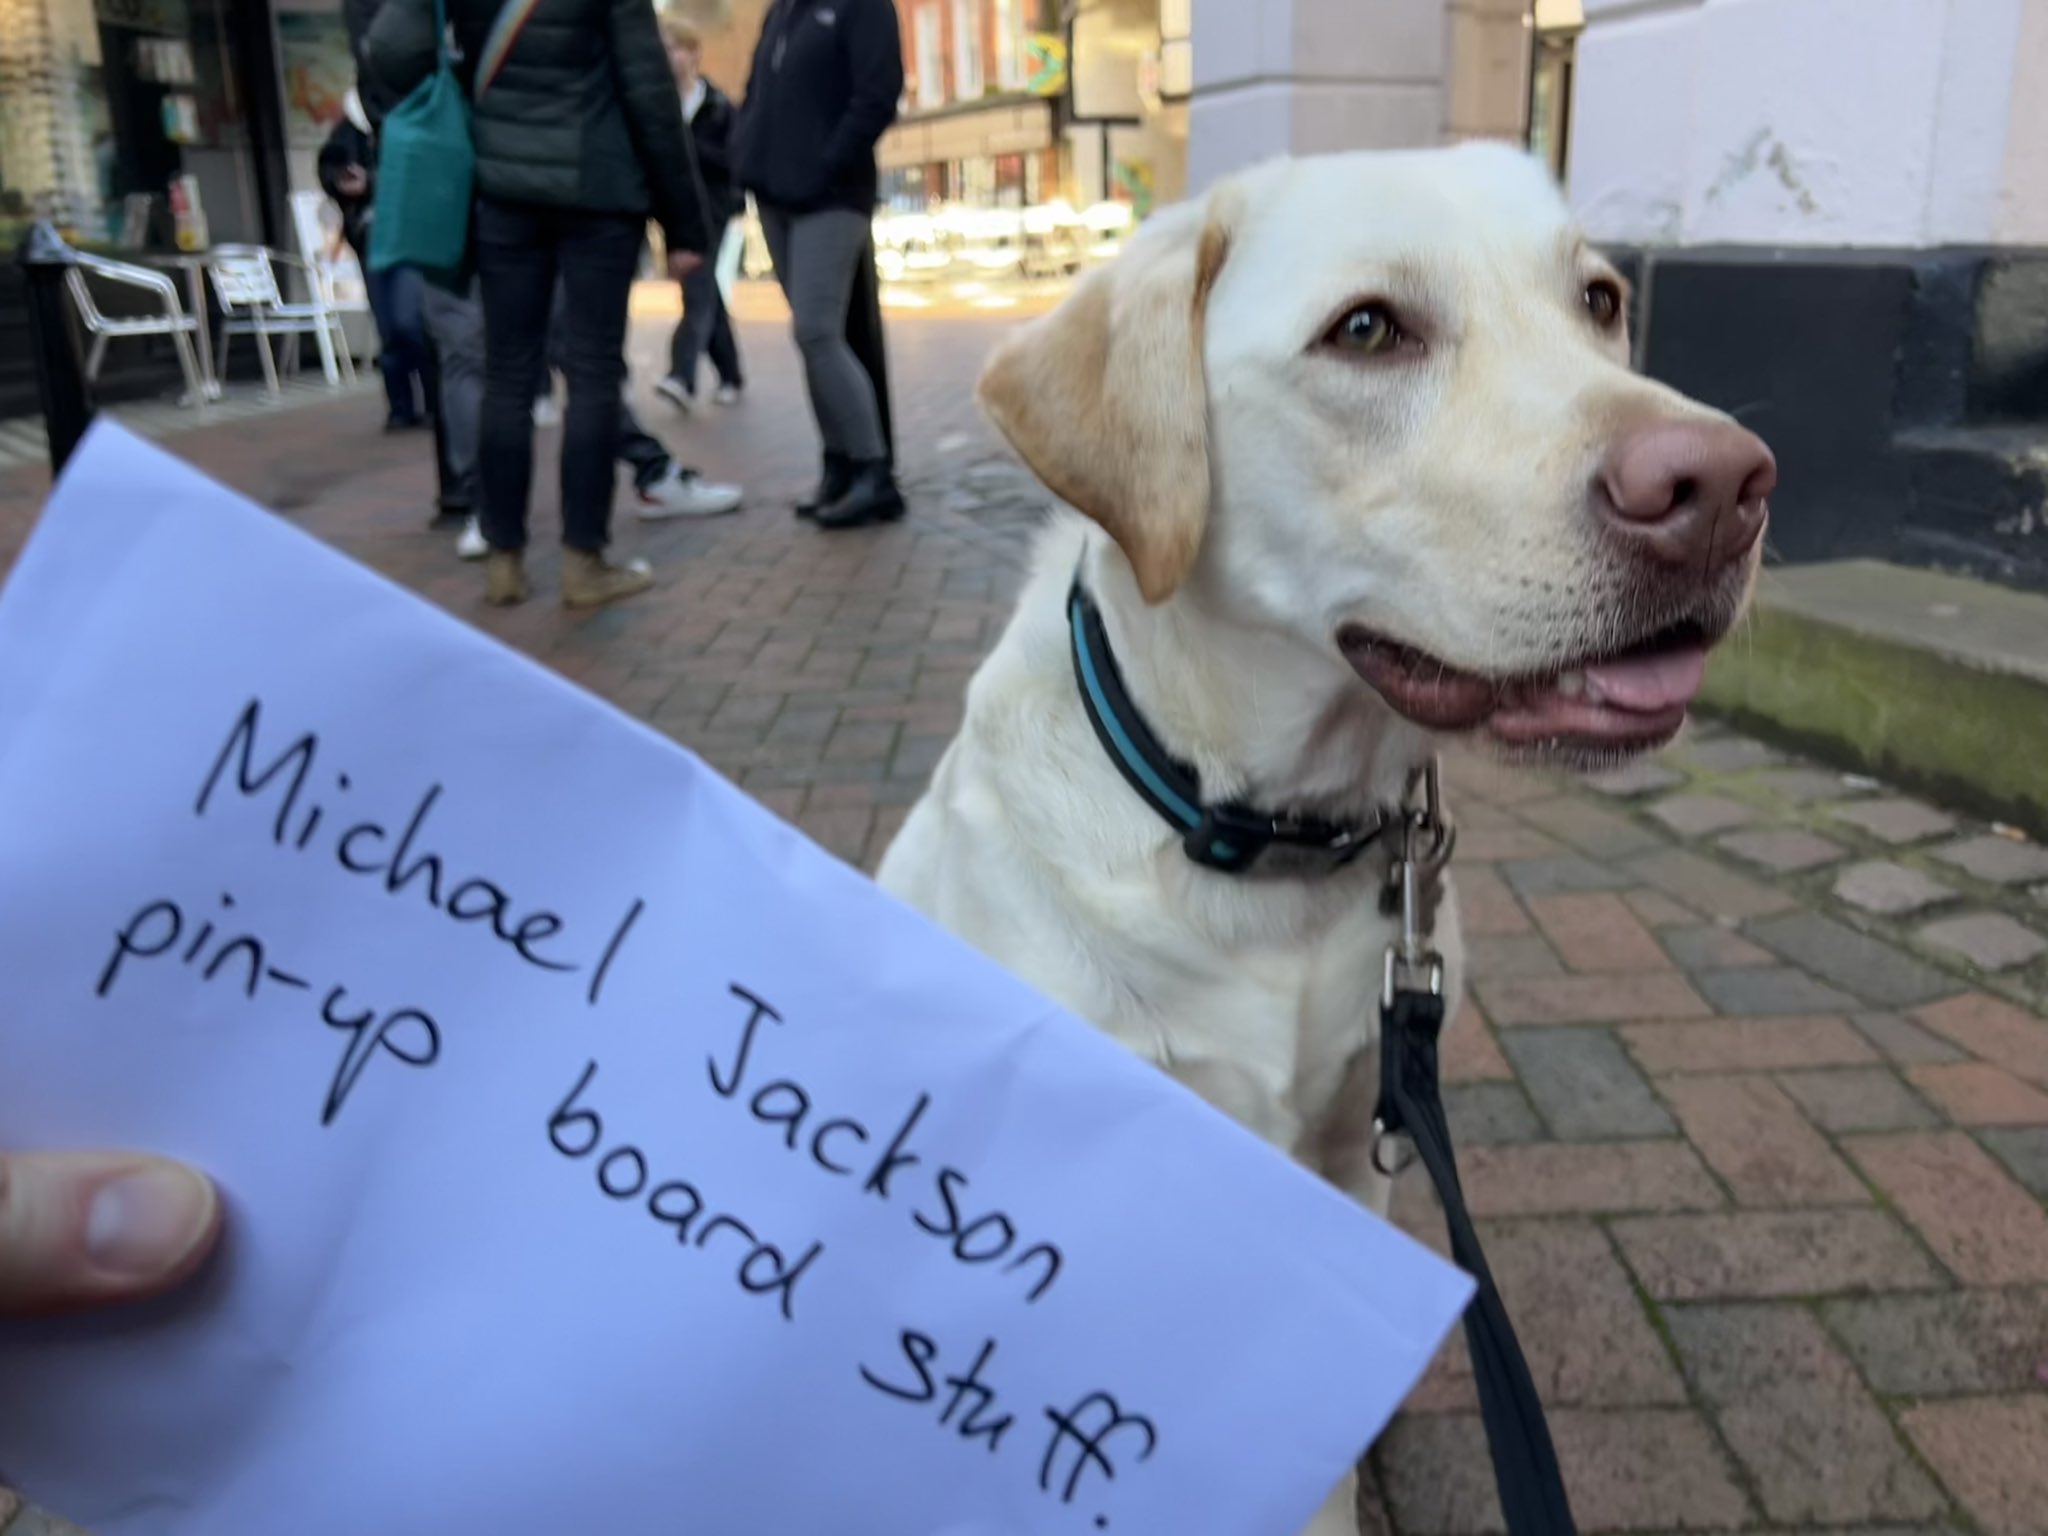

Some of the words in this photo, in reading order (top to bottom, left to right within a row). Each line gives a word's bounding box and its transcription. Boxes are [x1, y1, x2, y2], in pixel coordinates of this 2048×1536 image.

[95, 892, 442, 1128] pin-up
[545, 1059, 824, 1321] board
[859, 1328, 1158, 1530] stuff.
[194, 697, 646, 1006] Michael
[706, 982, 1064, 1304] Jackson
